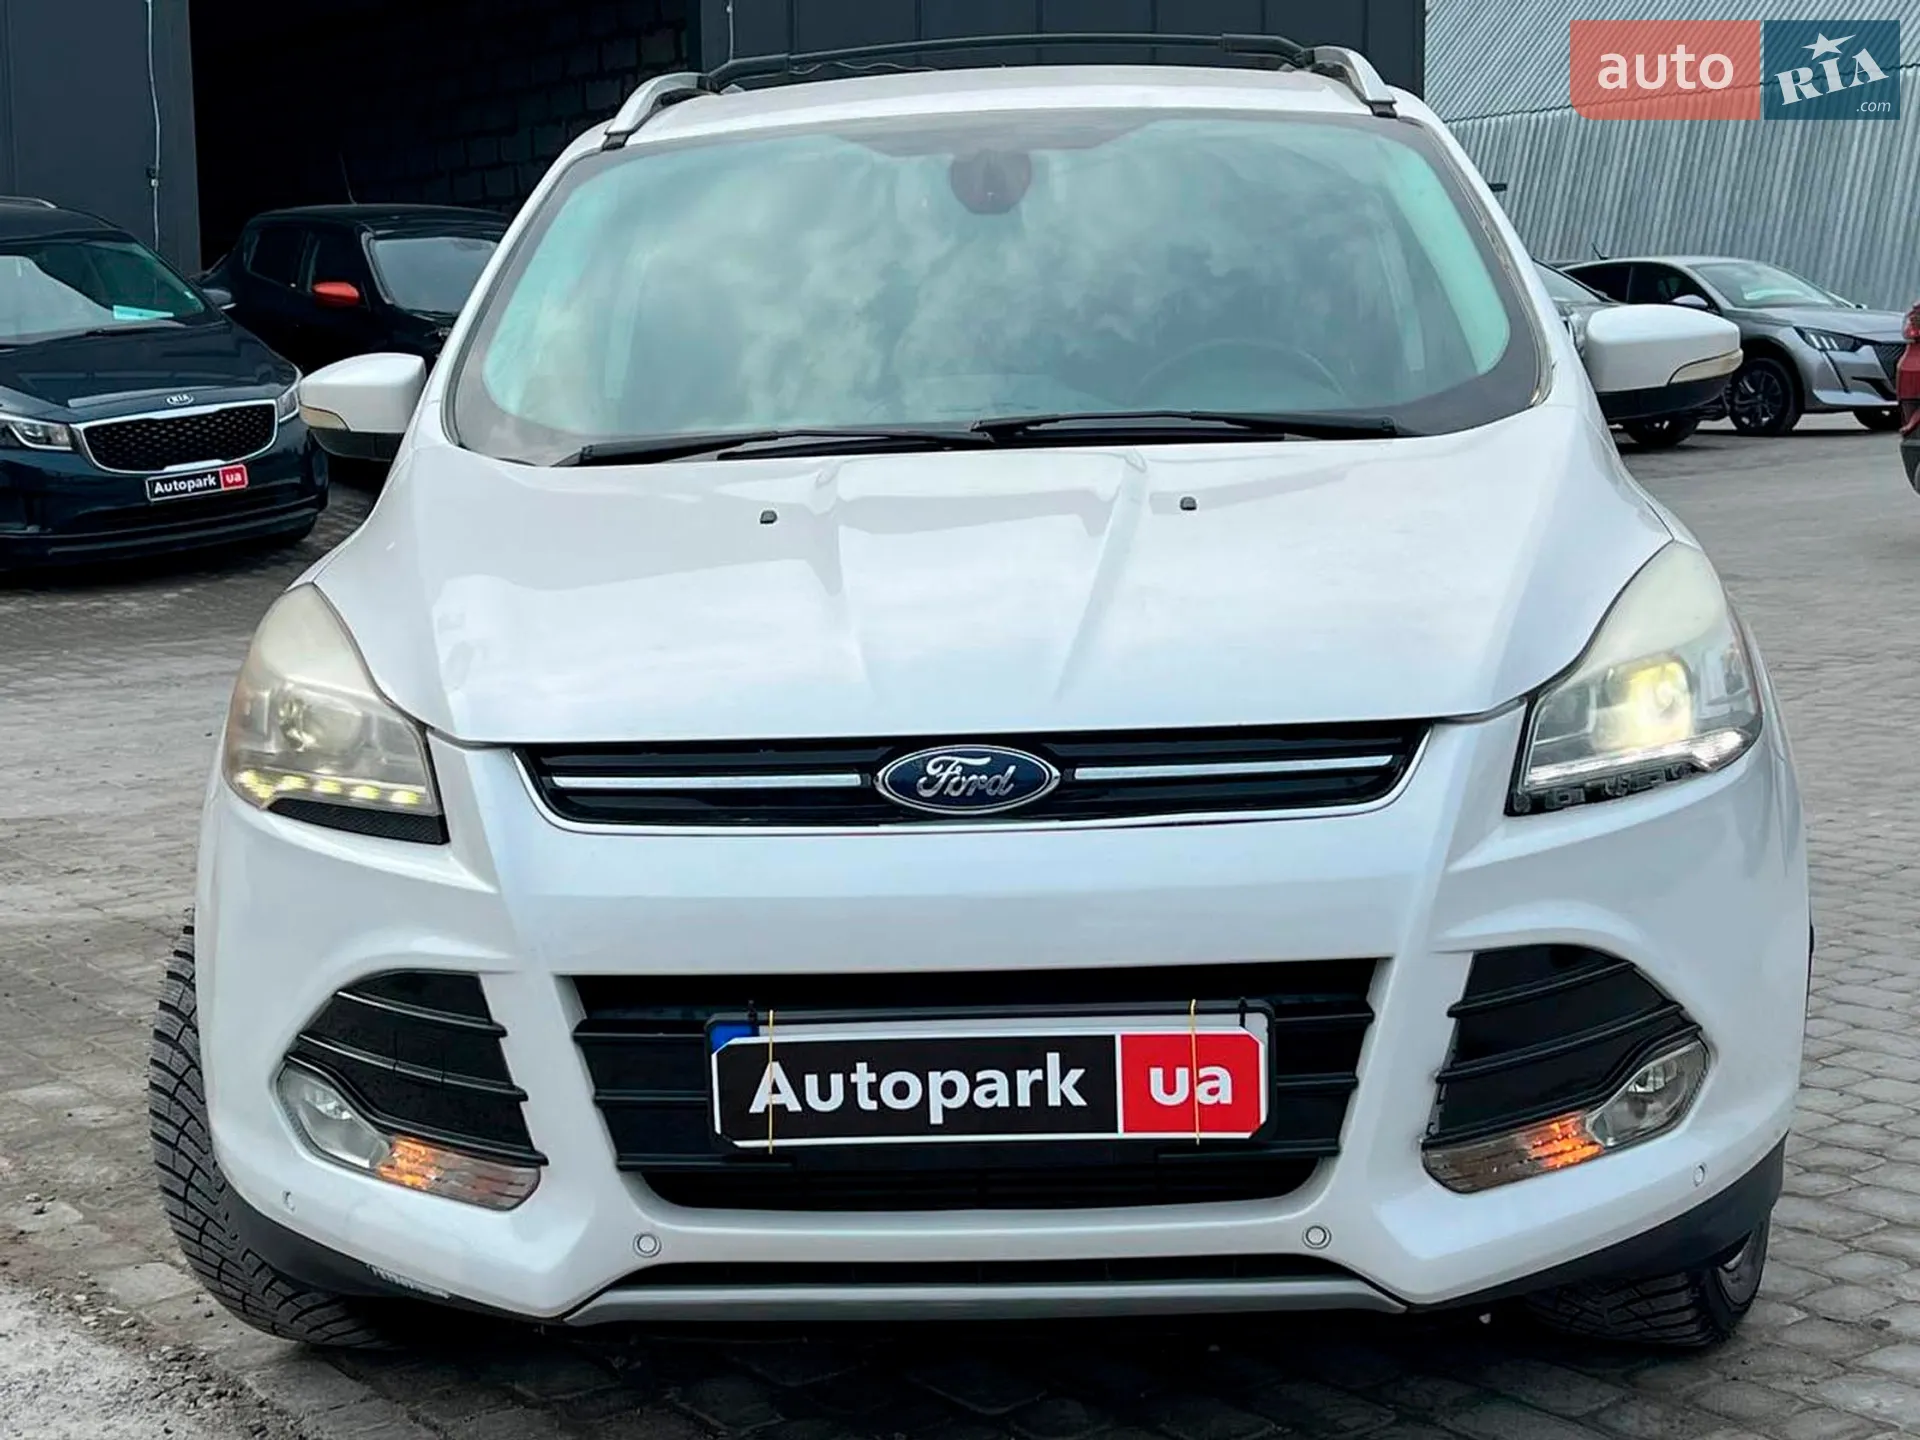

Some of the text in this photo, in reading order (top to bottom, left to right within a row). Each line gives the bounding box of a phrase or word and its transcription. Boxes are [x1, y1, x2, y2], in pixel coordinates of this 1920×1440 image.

[154, 473, 242, 493] Autopark ua
[916, 756, 1016, 797] Ford
[748, 1052, 1233, 1125] Autopark ua
